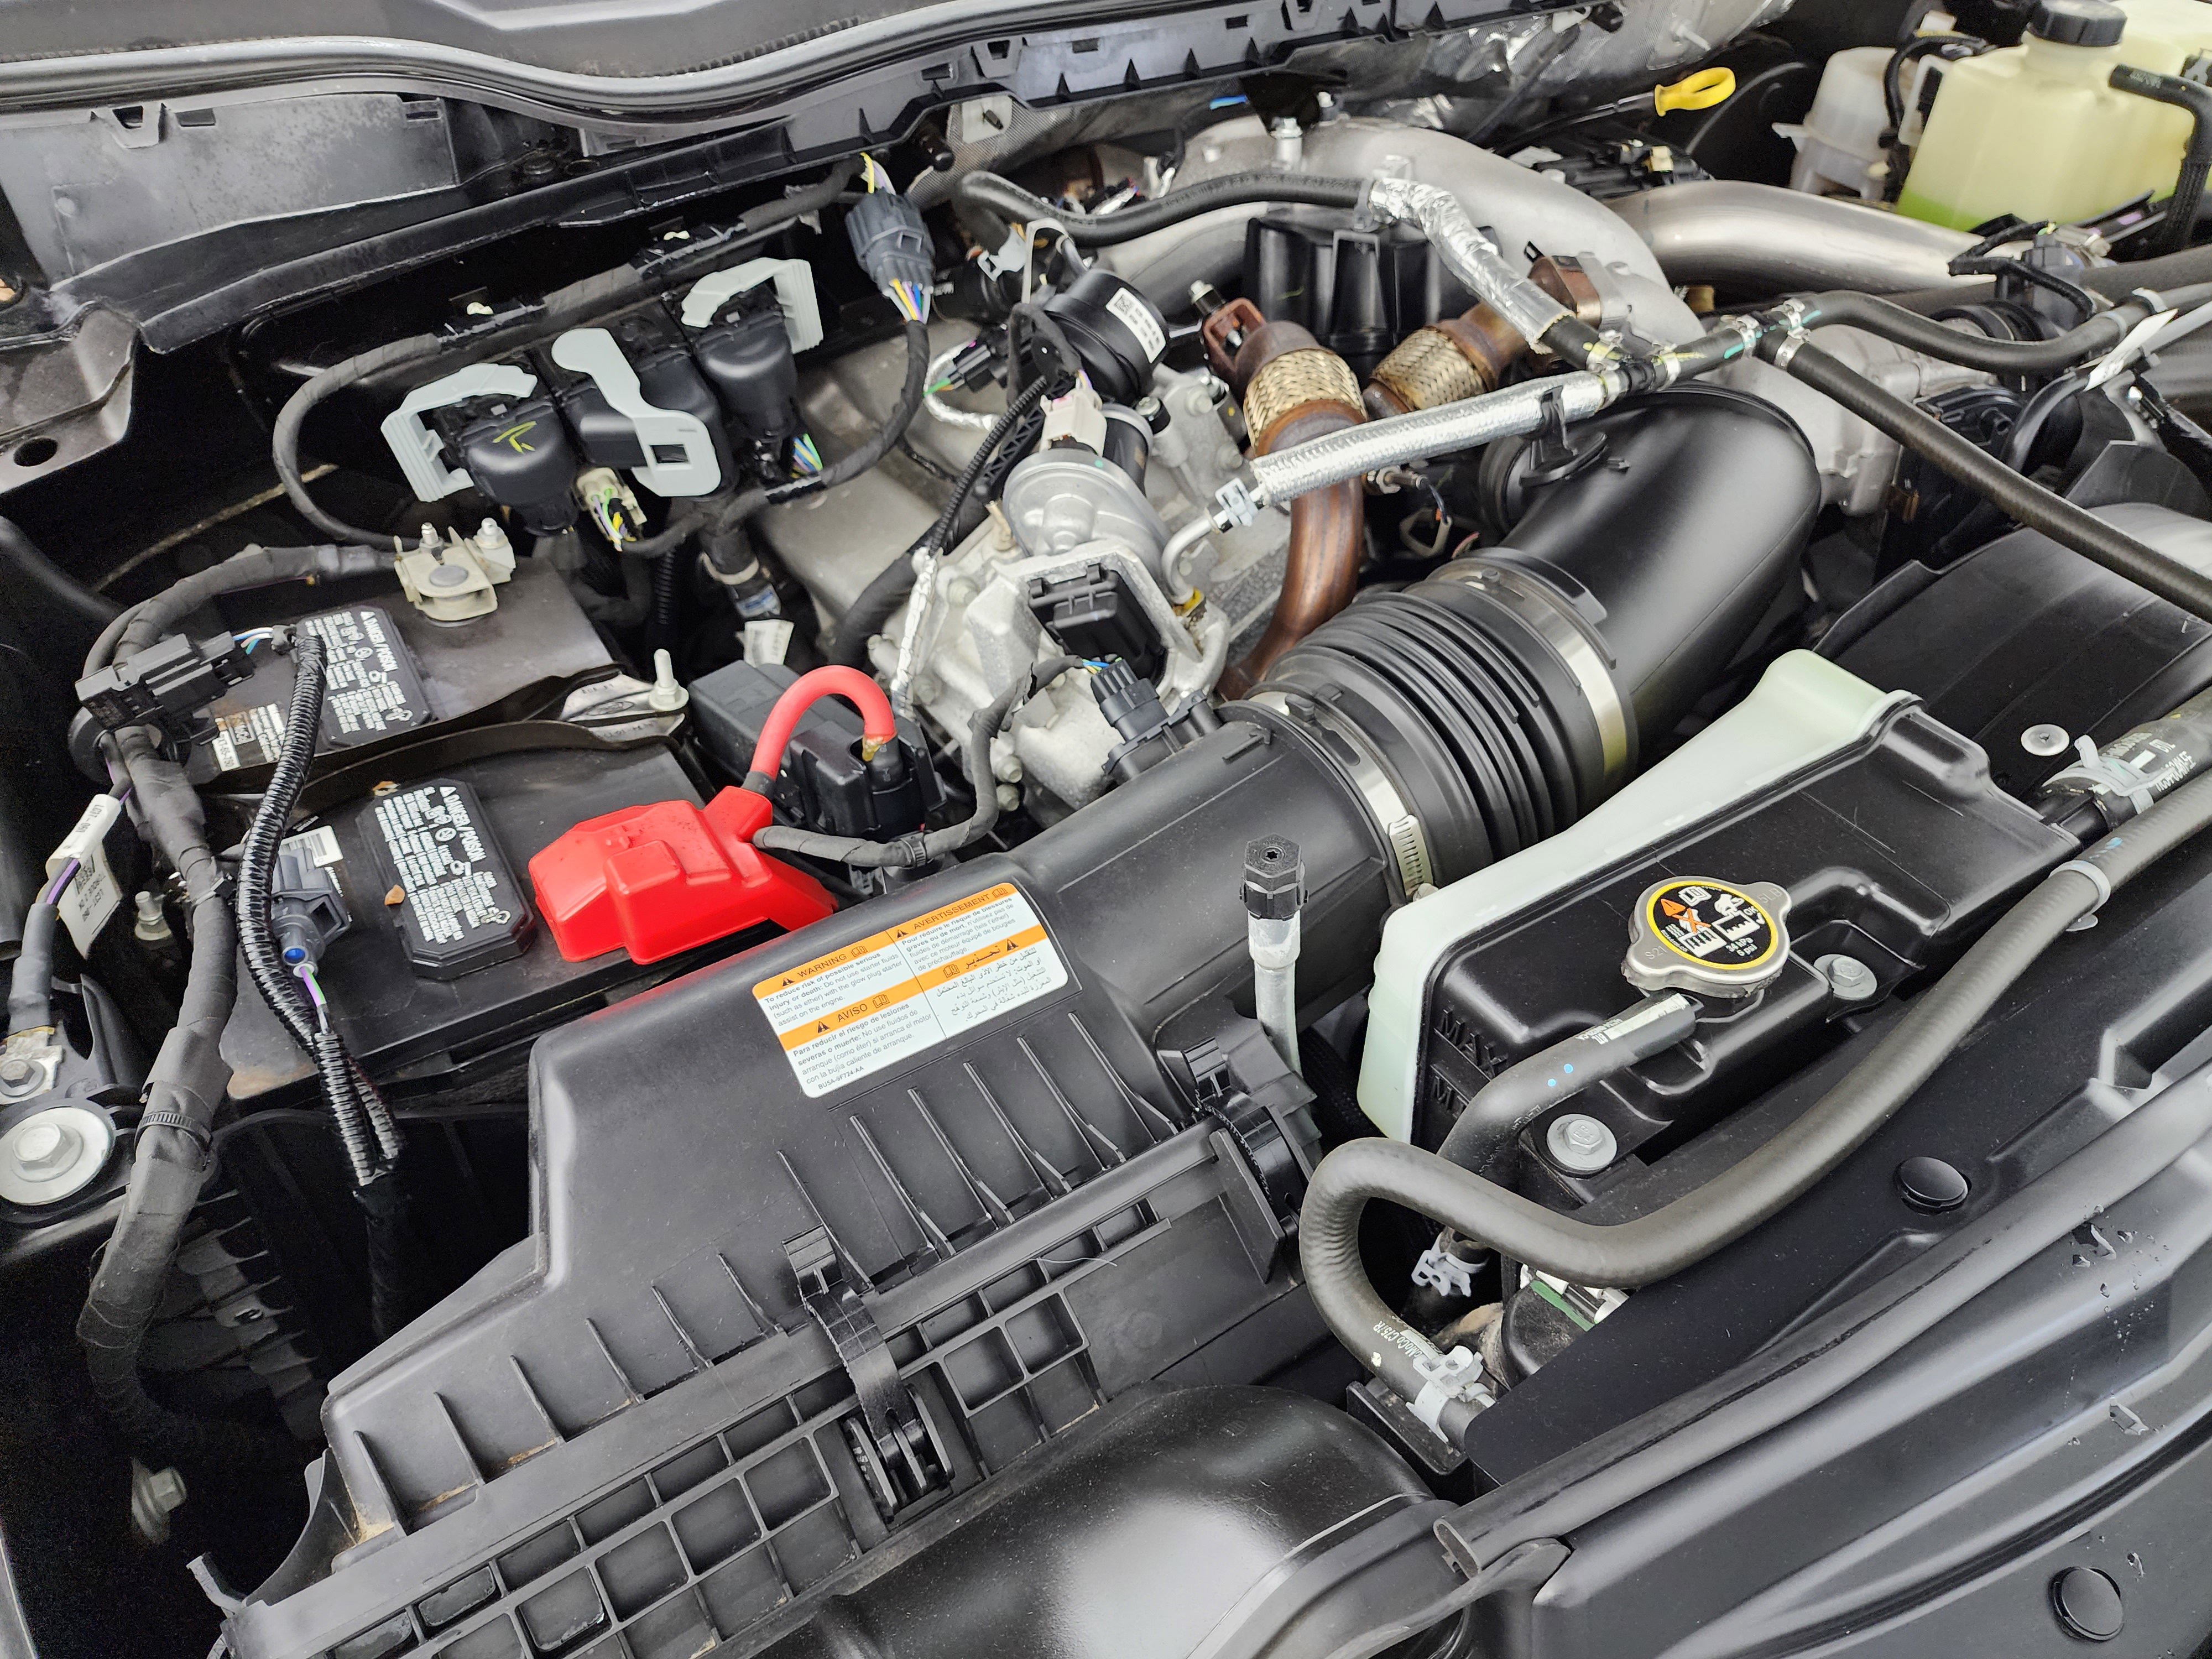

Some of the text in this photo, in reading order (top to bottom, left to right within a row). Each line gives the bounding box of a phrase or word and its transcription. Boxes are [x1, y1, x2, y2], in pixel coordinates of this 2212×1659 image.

[901, 935, 919, 945] Pour
[919, 925, 943, 938] réduire
[950, 914, 972, 926] risque
[981, 896, 1012, 912] blessures
[912, 893, 991, 930] AVERTISSEMENT
[1744, 906, 1759, 916] OK
[906, 939, 929, 952] graves
[909, 946, 931, 958] fluides
[940, 927, 974, 946] démarrage
[973, 921, 988, 931] (tels
[914, 954, 930, 964] avec
[938, 941, 961, 953] moteur
[961, 931, 983, 945] équipé
[991, 917, 1016, 932] bougies
[926, 946, 970, 968] préchauffage.
[769, 998, 791, 1011] injury
[800, 984, 823, 998] death:
[846, 970, 859, 978] use
[859, 961, 881, 972] starter
[880, 953, 899, 963] fluids
[775, 985, 800, 999] reduce
[801, 979, 815, 988] risk
[824, 963, 855, 979] possible
[855, 952, 880, 966] serious
[797, 953, 847, 978] WARNING
[773, 1006, 793, 1019] (such
[802, 993, 824, 1006] ether)
[823, 987, 838, 997] with
[838, 982, 849, 990] the
[849, 975, 867, 987] glow
[866, 969, 882, 980] plug
[881, 960, 902, 973] starter
[777, 1014, 798, 1026] assist
[808, 1004, 820, 1013] the
[820, 994, 846, 1009] engine.
[792, 1045, 811, 1057] Para
[811, 1033, 838, 1048] reducir
[846, 1019, 870, 1035] riesgo
[879, 1002, 910, 1019] lesiones
[836, 1003, 868, 1022] AVISO
[797, 1050, 827, 1066] severas
[833, 1034, 862, 1050] muerte:
[861, 1028, 873, 1037] No
[873, 1023, 886, 1032] use
[886, 1013, 909, 1026] fluidos
[801, 1057, 833, 1076] arranque
[832, 1047, 856, 1062] (como
[854, 1039, 873, 1052] éter)
[879, 1026, 905, 1040] arranca
[912, 1013, 932, 1025] motor
[805, 1074, 820, 1084] con
[844, 1050, 872, 1066] caliente
[872, 1046, 882, 1054] de
[882, 1032, 915, 1051] arranque.
[1396, 1336, 1423, 1358] oMoCo
